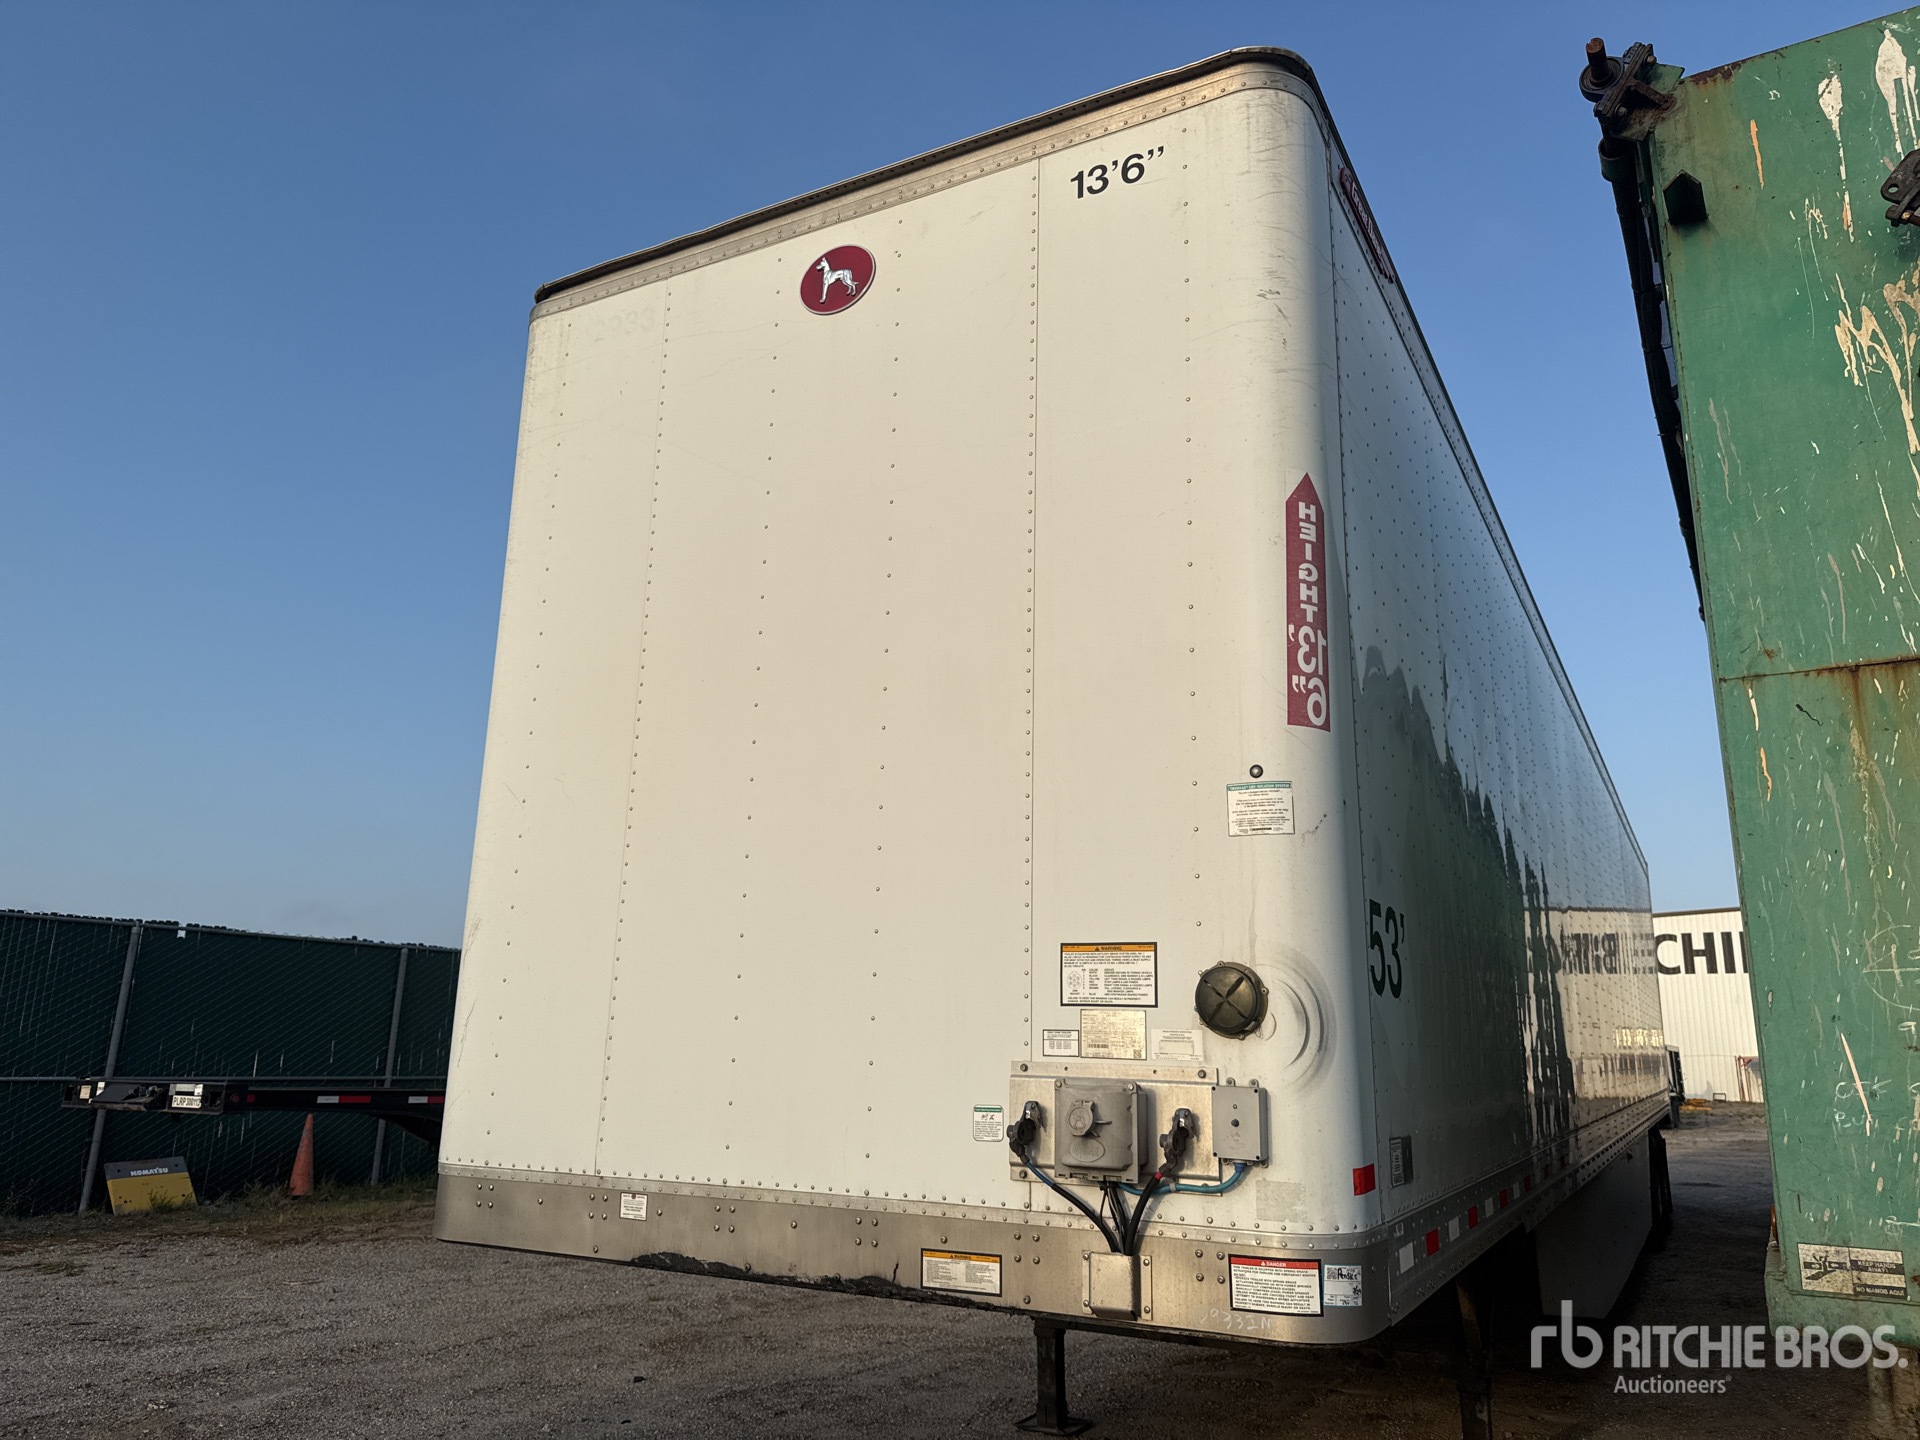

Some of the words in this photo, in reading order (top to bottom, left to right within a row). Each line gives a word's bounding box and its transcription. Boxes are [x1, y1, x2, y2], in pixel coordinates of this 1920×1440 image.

[1369, 899, 1404, 998] 53'
[1654, 932, 1748, 975] CHI
[130, 1167, 168, 1176] KOMATSU
